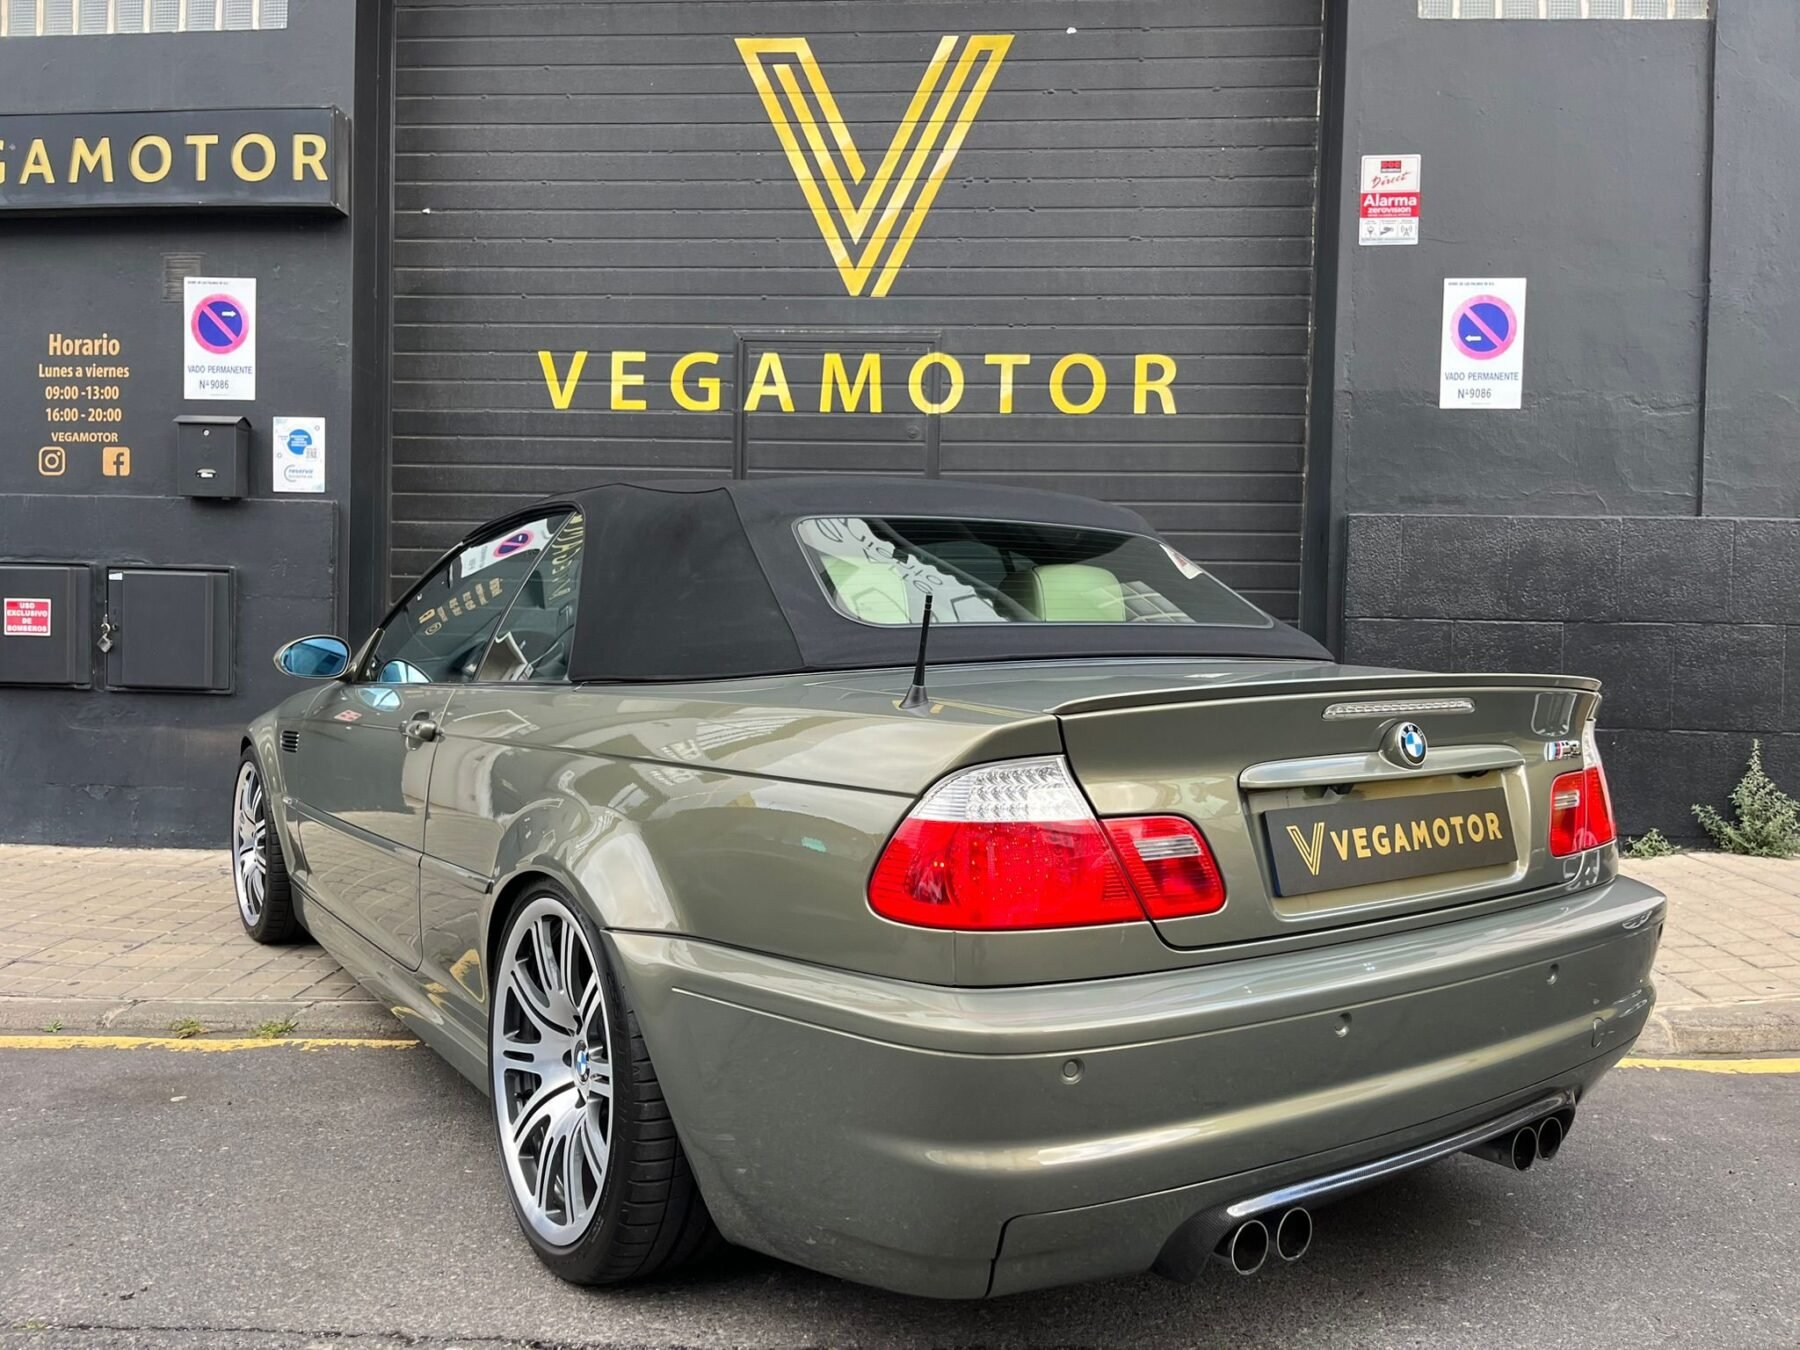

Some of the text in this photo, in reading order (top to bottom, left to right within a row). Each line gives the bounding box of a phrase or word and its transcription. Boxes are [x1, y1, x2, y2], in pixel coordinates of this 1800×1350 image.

[0, 132, 329, 184] AMOTOR
[1363, 193, 1417, 207] Alarma
[1367, 206, 1411, 214] zerovision
[48, 333, 120, 356] Horario
[38, 363, 130, 378] Lunes a viernes
[187, 365, 253, 375] VADO PERMANENTE
[1445, 371, 1519, 381] VADO PERMANENTE
[537, 351, 1177, 414] VEGAMOTOR
[45, 386, 79, 400] 09:00
[46, 407, 79, 421] 16:00
[87, 407, 122, 421] 20:00
[51, 432, 119, 442] VEGAMOTOR
[7, 609, 48, 617] EXCLUSIVO
[1329, 812, 1503, 861] VEGAMOTOR
